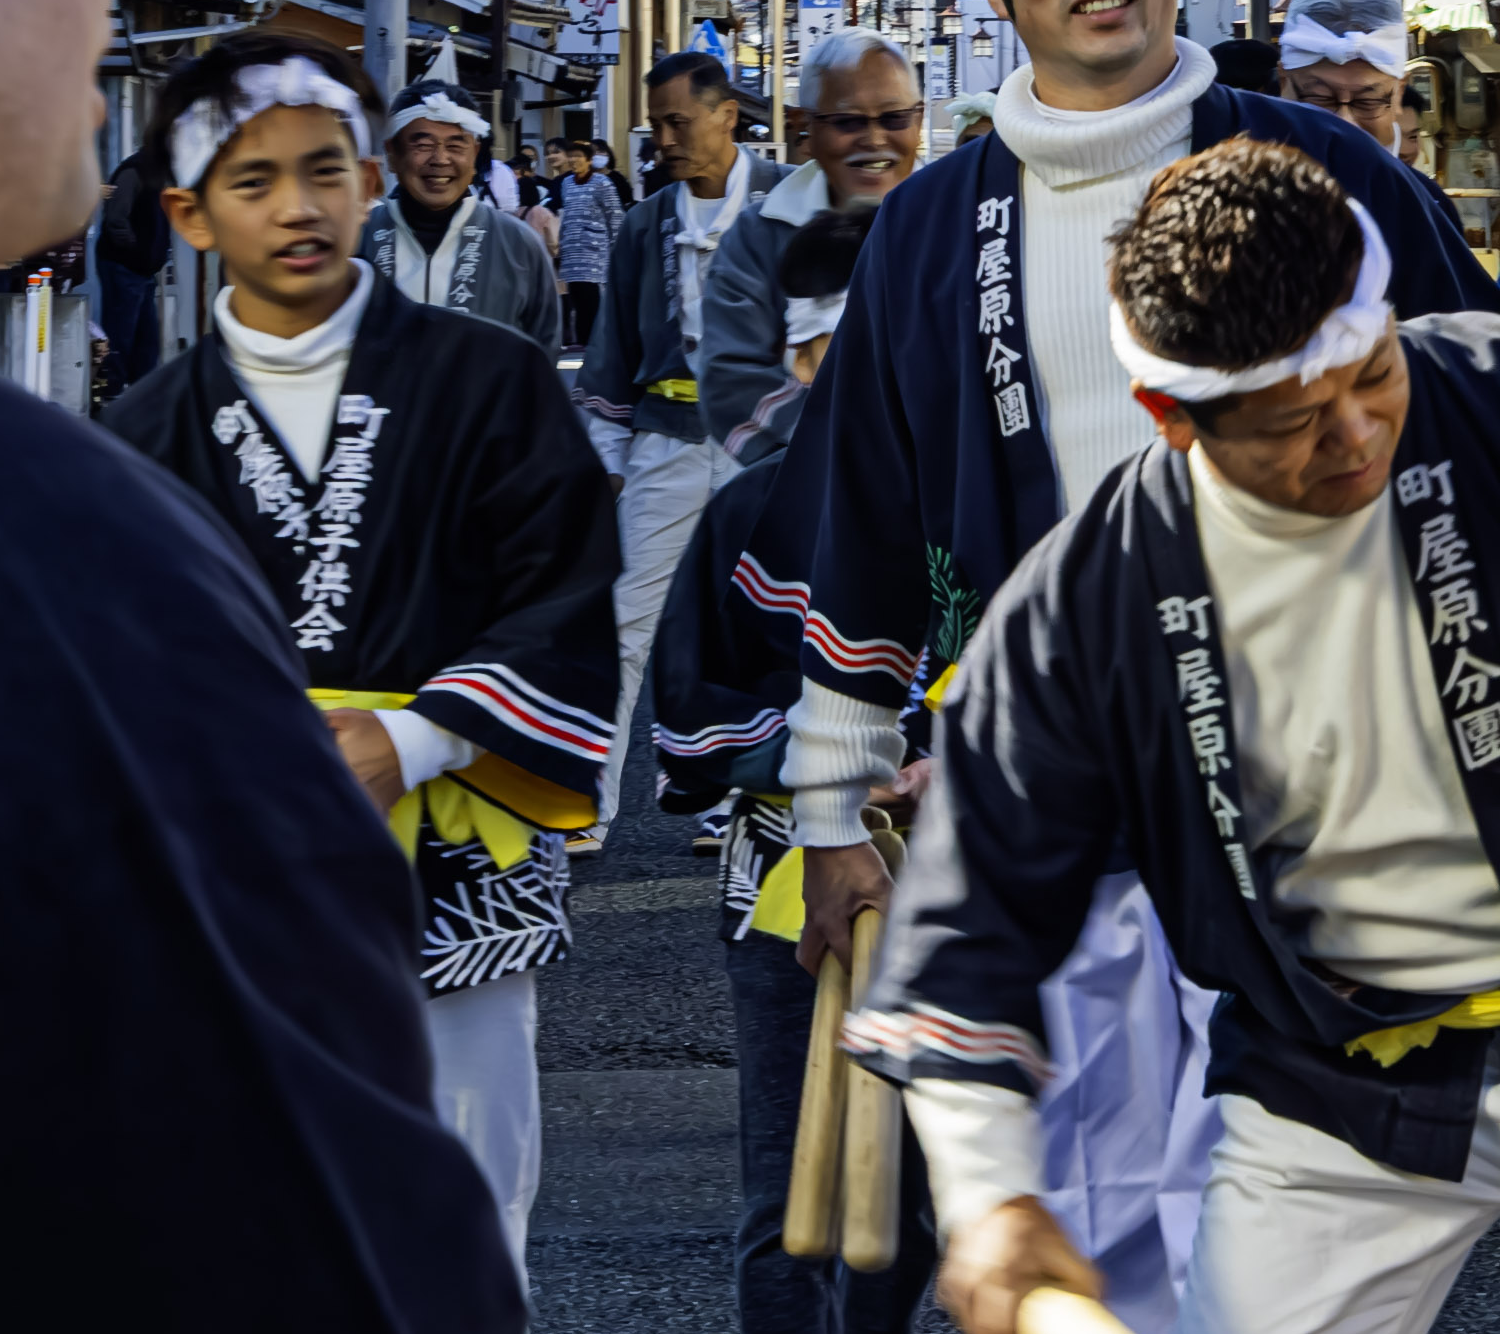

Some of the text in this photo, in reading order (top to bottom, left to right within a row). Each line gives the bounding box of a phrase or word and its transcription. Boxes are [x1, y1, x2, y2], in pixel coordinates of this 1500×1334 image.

[449, 225, 488, 313] 町屋原分
[288, 394, 392, 652] 町屋原子供会
